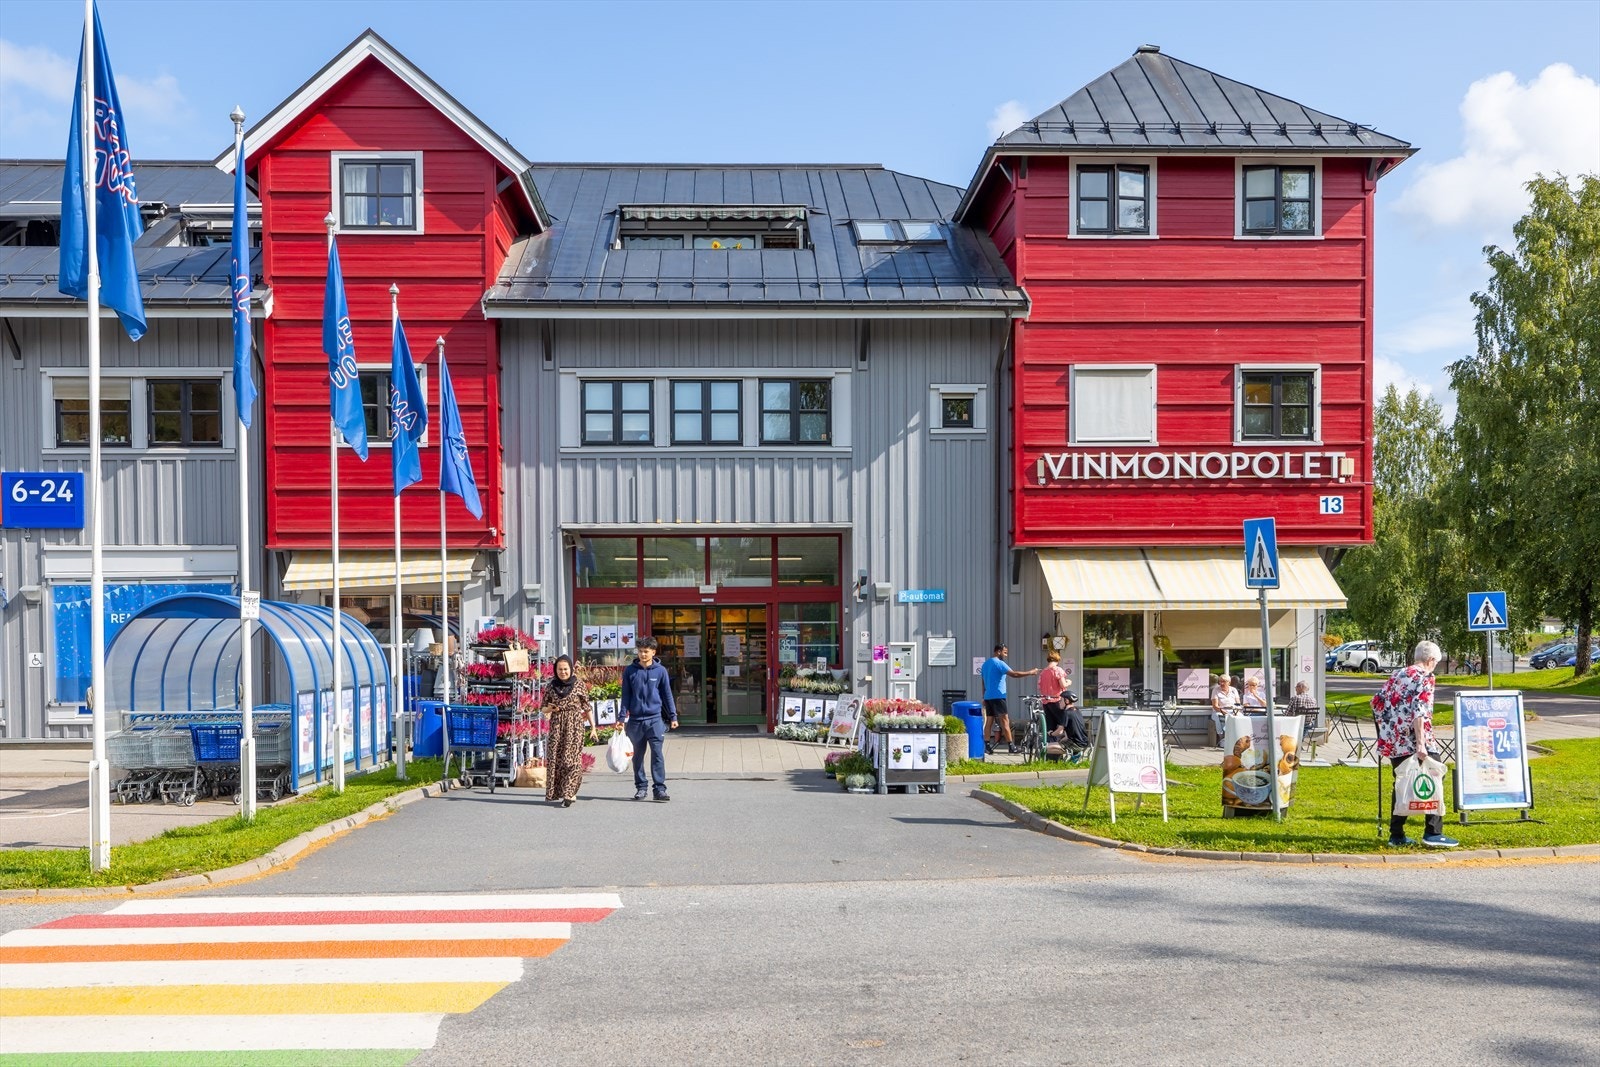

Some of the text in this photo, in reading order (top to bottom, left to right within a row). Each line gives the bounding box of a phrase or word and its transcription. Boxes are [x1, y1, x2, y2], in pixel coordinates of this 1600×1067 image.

[1044, 451, 1346, 480] VINMONOPOLET
[12, 479, 73, 502] 6-24
[1322, 497, 1342, 513] 13
[1496, 730, 1510, 752] 24
